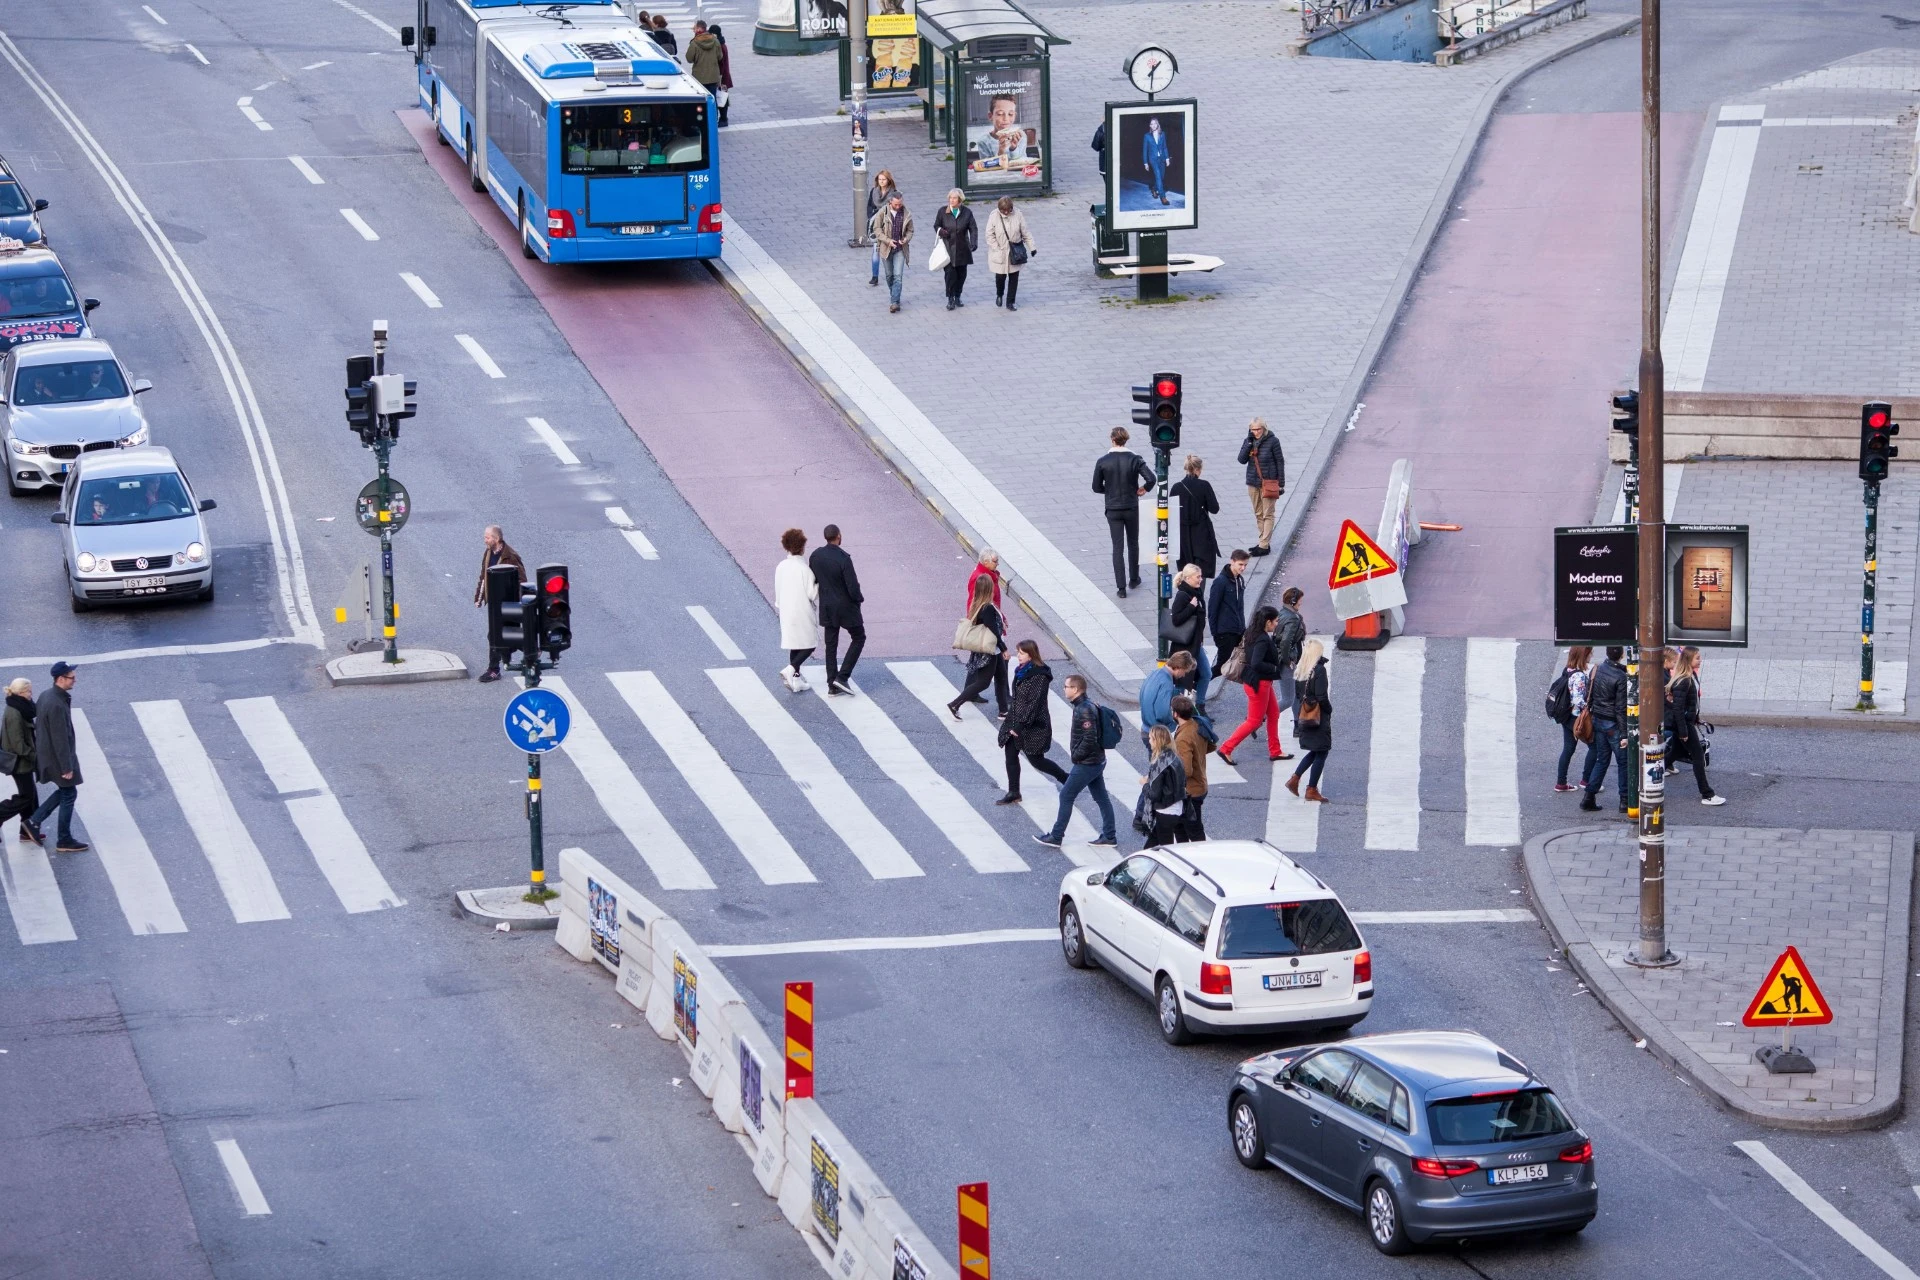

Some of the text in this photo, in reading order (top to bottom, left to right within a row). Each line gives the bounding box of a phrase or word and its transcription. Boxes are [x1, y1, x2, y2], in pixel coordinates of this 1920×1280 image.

[801, 17, 846, 31] RODIN
[872, 68, 893, 82] Fanta
[623, 109, 632, 123] 3
[689, 174, 710, 183] 7186
[0, 323, 78, 338] OPCAB
[124, 577, 164, 588] TSY 339
[1569, 572, 1623, 584] Moderna
[1271, 975, 1292, 987] JNW
[1299, 973, 1320, 984] 054
[1497, 1168, 1518, 1181] KLP
[1524, 1166, 1544, 1178] 156
